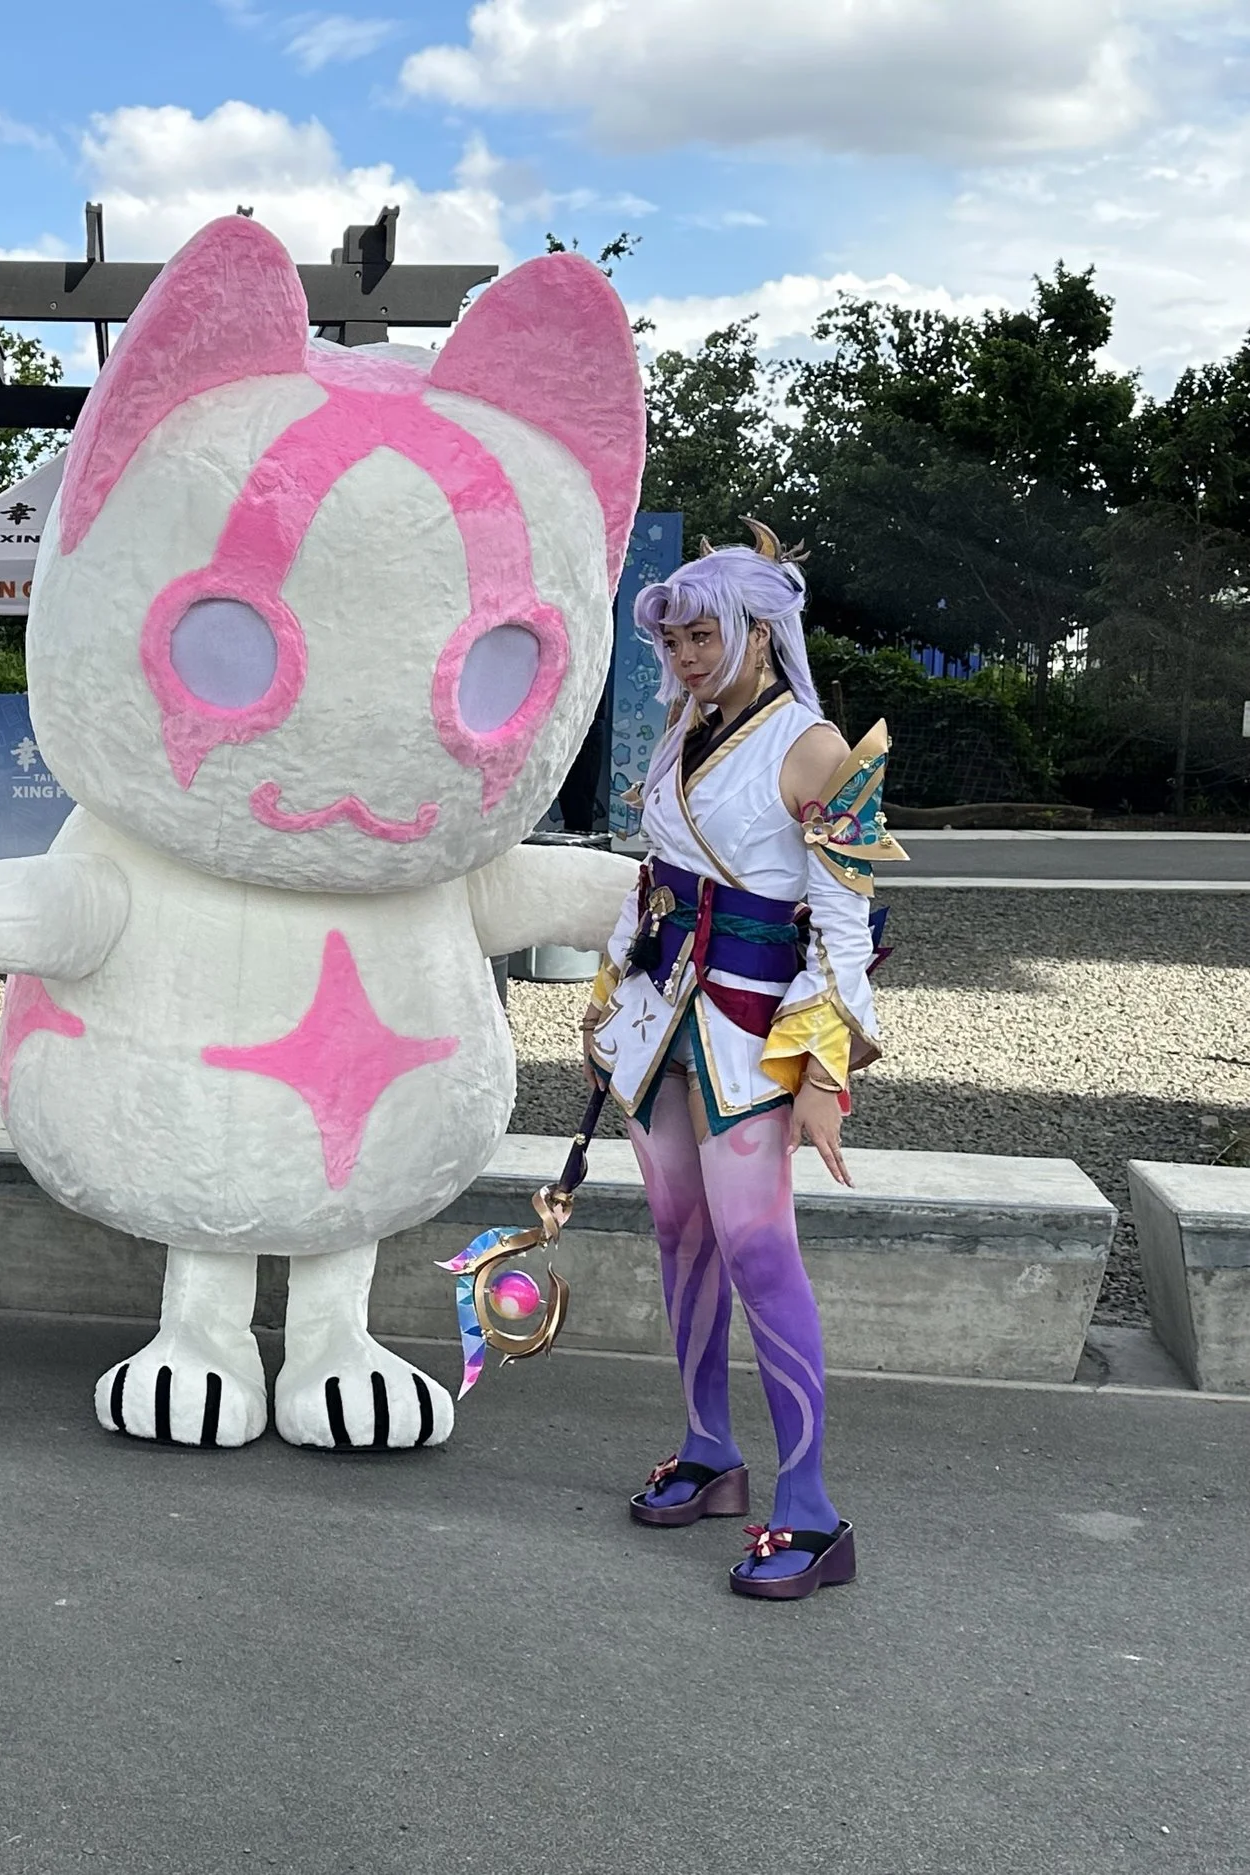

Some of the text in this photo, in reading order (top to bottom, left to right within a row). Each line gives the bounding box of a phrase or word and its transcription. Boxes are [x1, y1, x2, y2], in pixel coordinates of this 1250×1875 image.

[0, 502, 37, 525] 幸
[0, 534, 40, 543] XIN
[10, 736, 39, 772] 幸
[12, 786, 54, 798] XING
